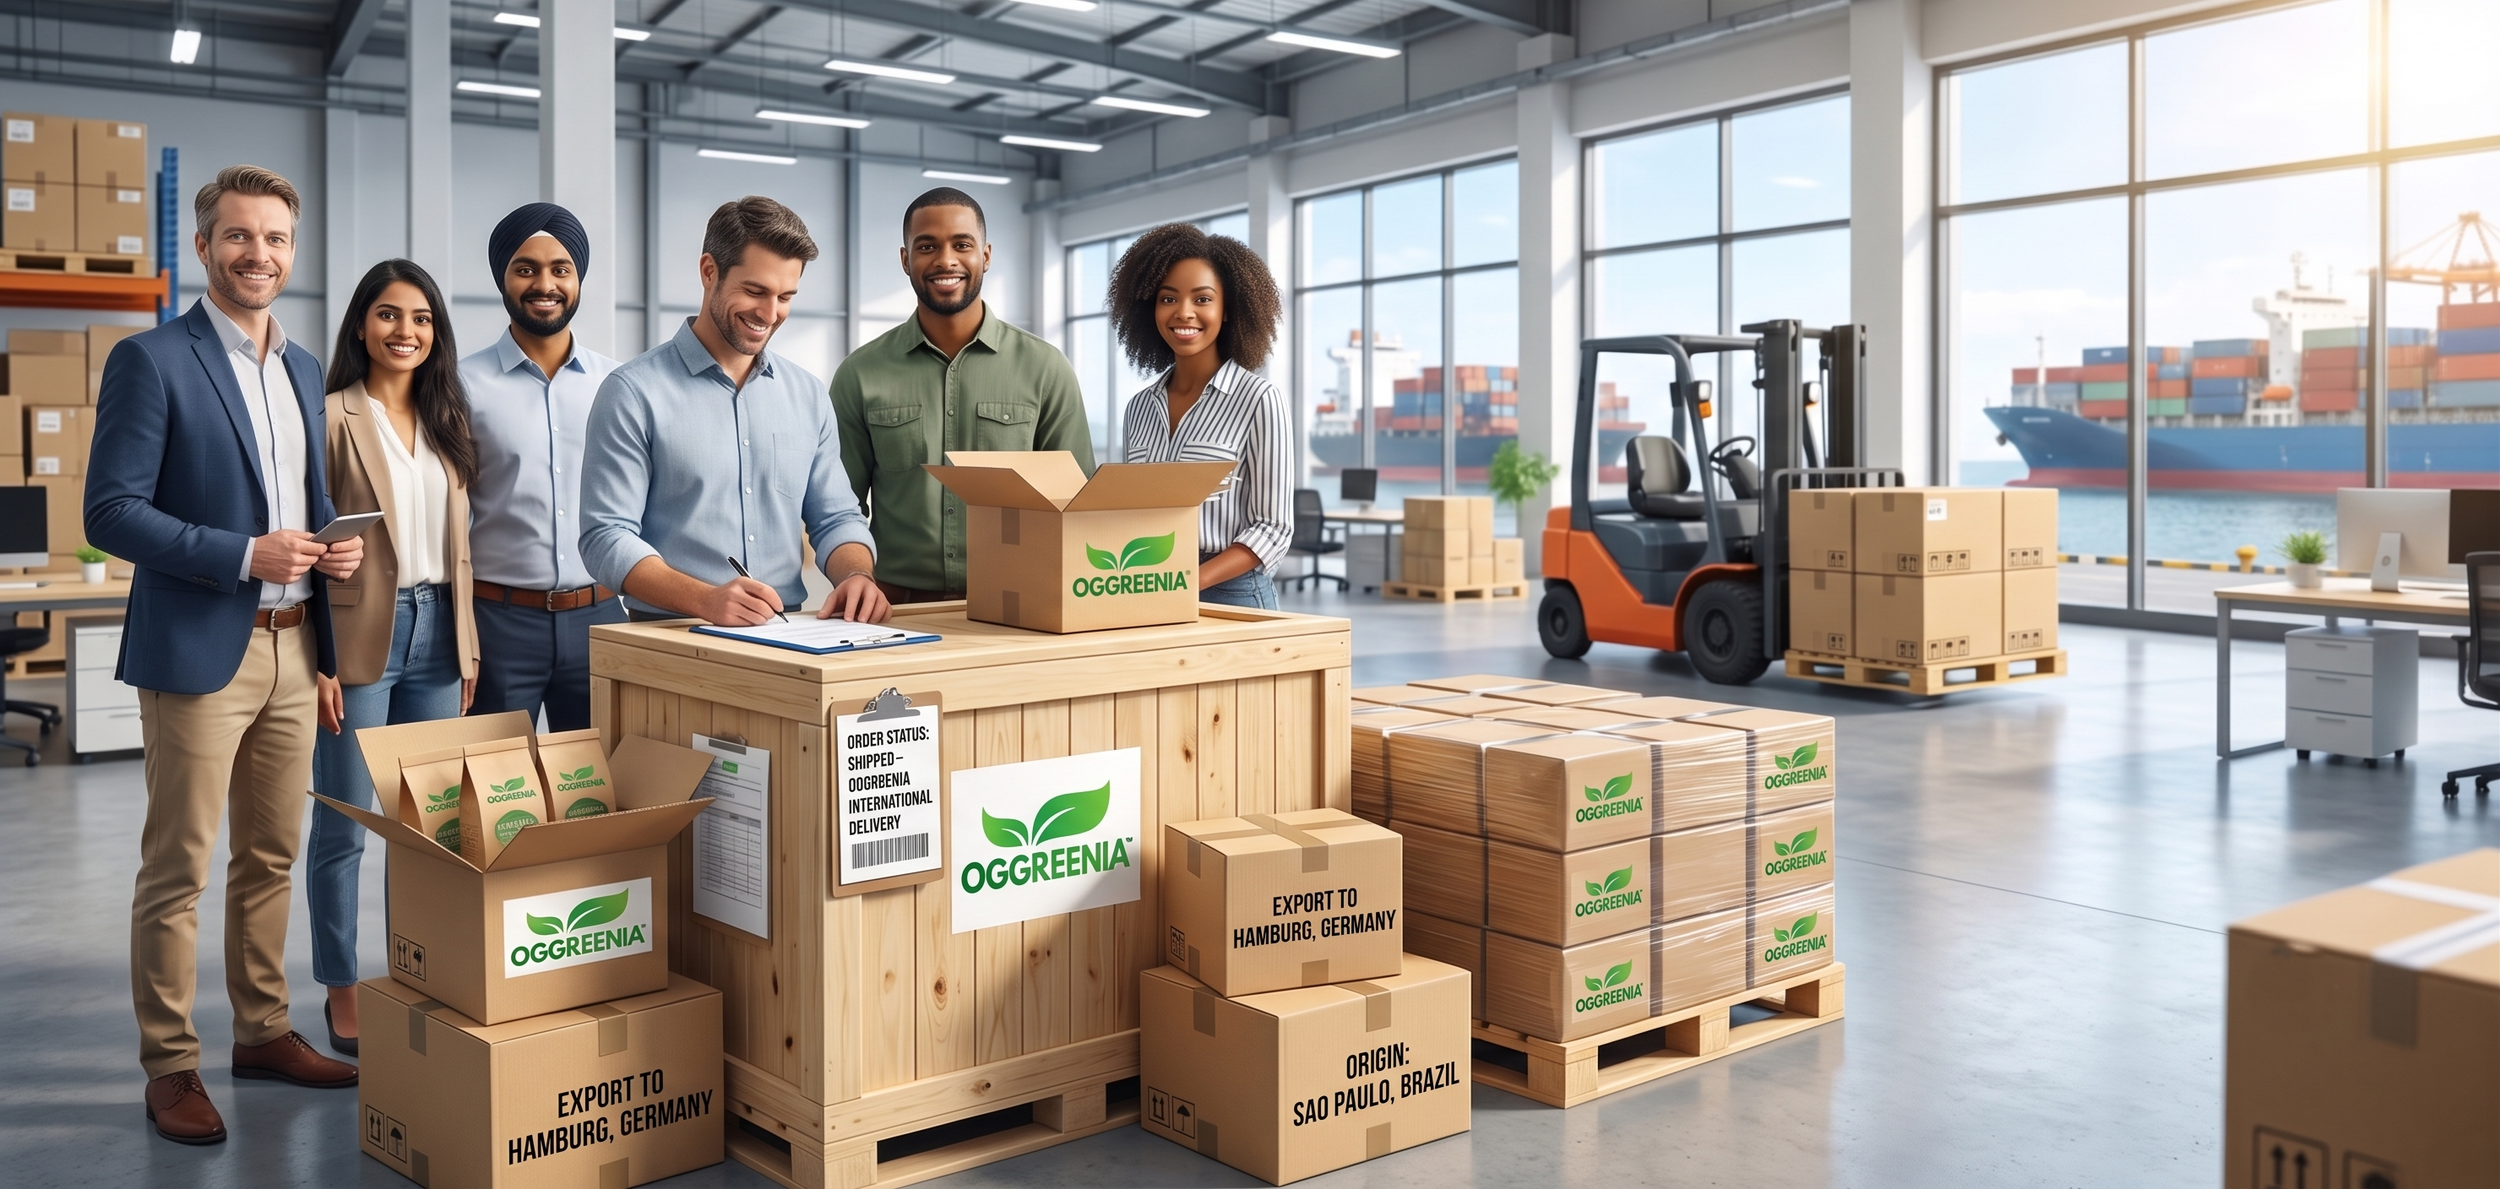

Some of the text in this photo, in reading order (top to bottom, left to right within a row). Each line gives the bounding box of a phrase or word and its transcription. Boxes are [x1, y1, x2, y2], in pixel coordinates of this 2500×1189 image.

[847, 726, 930, 750] ORDER STATUS:
[848, 771, 911, 793] OOGRBENIA
[849, 789, 933, 814] INTERNATIONAL
[849, 815, 901, 836] DELIVERY
[1273, 887, 1357, 916] EXPORT TO
[1233, 909, 1397, 949] HAMBURG, GERMANY
[1346, 1042, 1410, 1079] ORIGIN:
[558, 1068, 664, 1118] EXPORT TO
[1293, 1061, 1460, 1127] SAO PAULO, BRAZIL
[508, 1088, 713, 1165] HAMBURG, GERMANY
